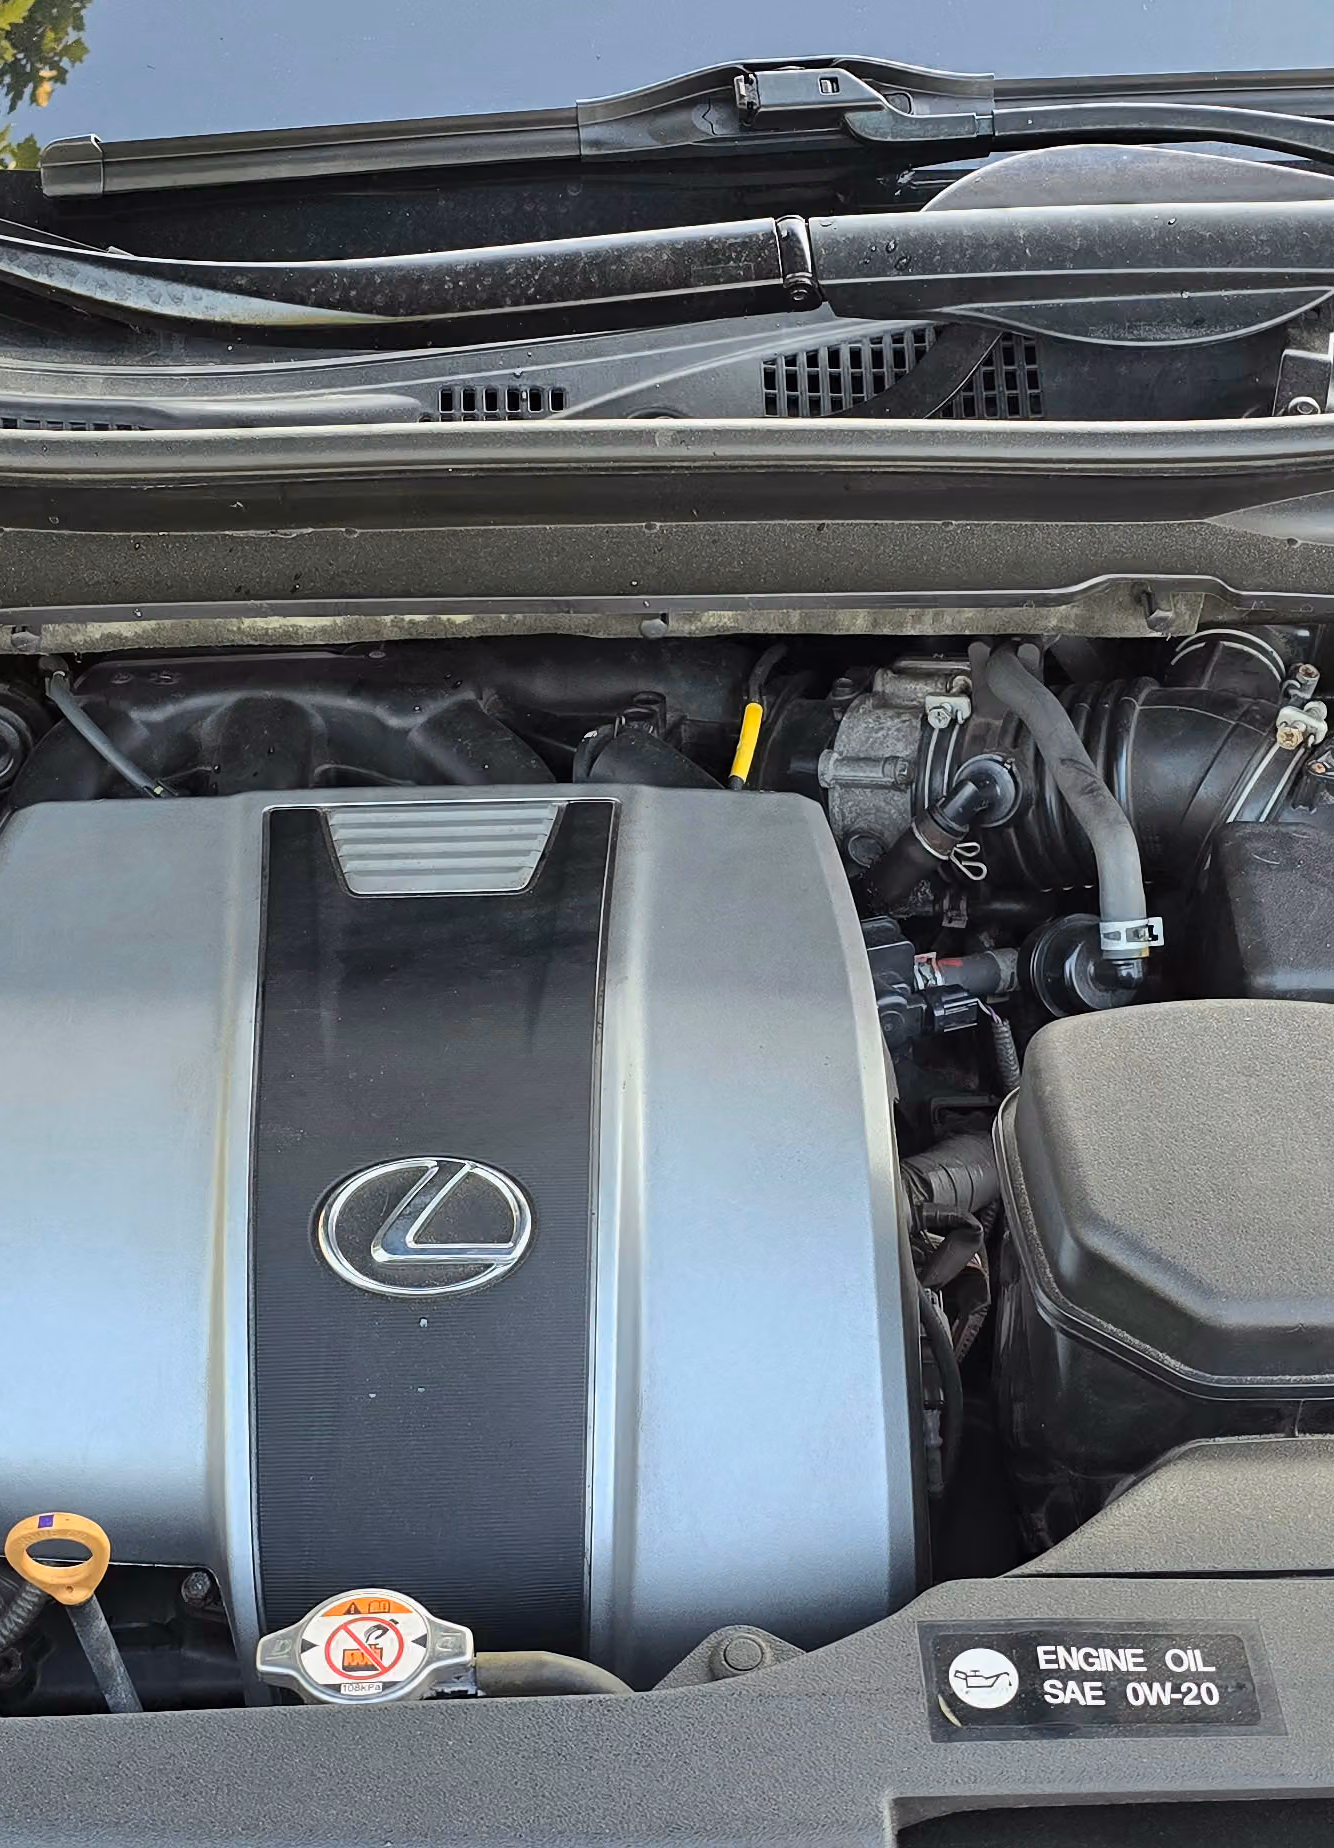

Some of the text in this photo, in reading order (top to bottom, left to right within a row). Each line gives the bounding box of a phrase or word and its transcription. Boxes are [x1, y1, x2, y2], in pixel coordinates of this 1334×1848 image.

[1037, 1645, 1216, 1672] ENGINE OIL
[1043, 1680, 1219, 1706] SAE 0W-20
